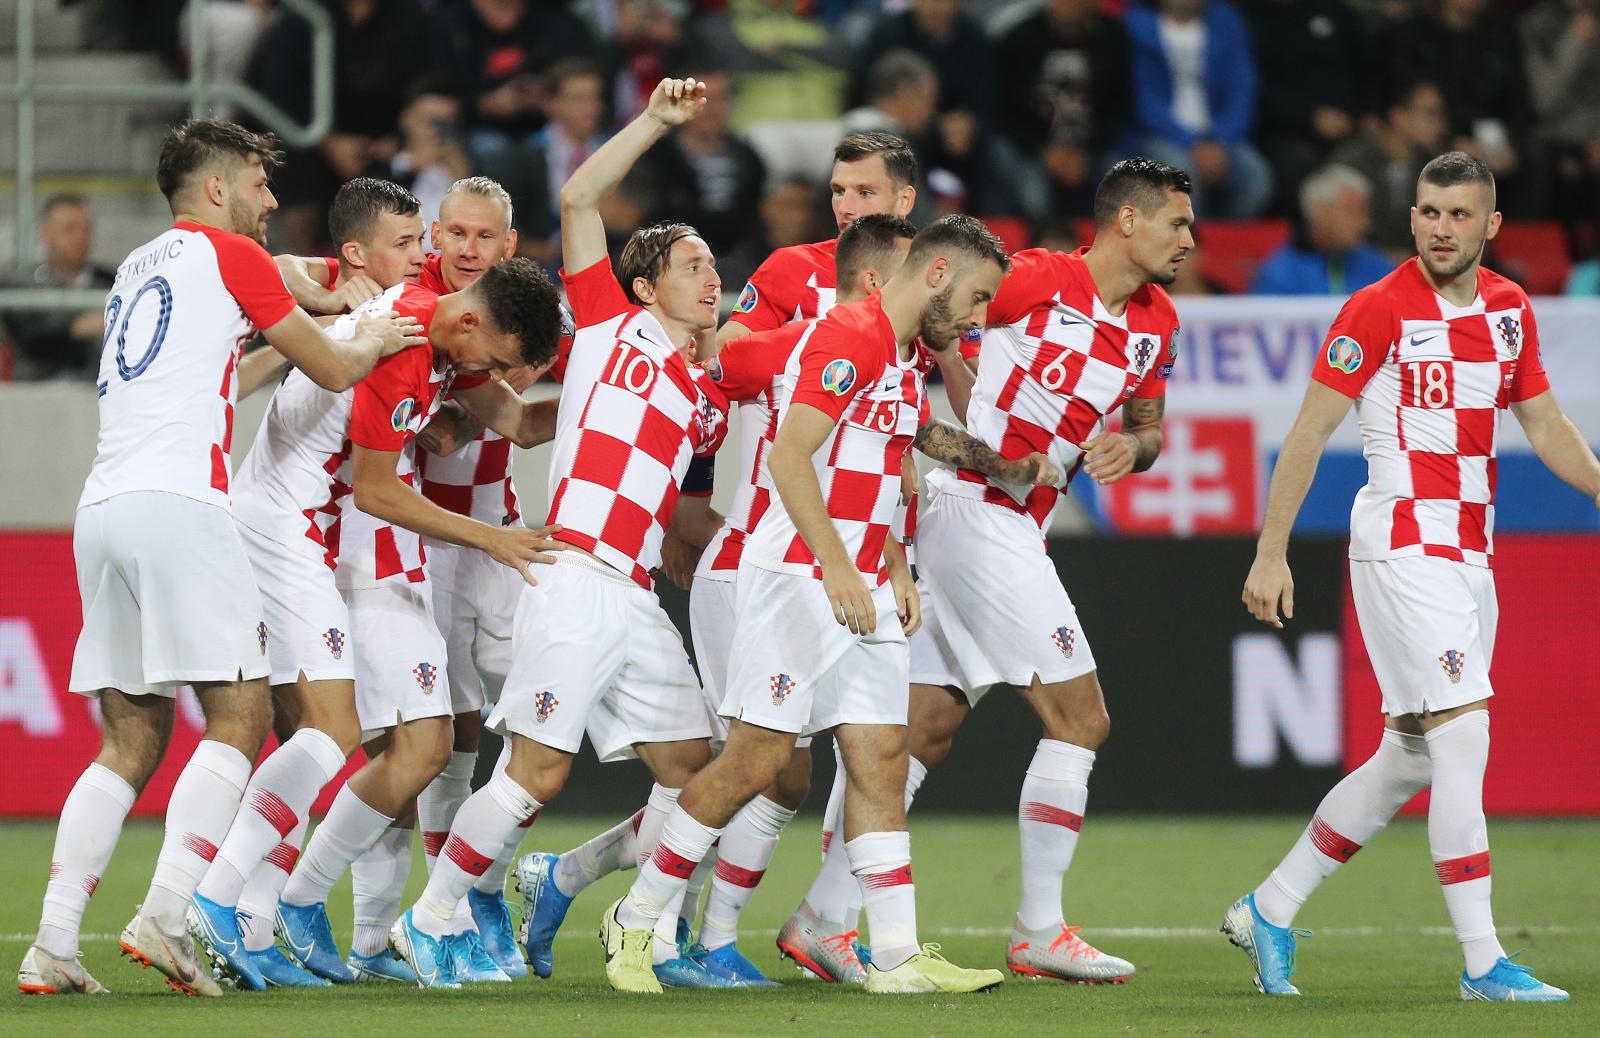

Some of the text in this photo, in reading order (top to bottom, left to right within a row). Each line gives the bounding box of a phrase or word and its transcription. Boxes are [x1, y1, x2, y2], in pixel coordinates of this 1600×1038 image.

[608, 342, 656, 395] 10
[1040, 348, 1073, 391] 6
[1407, 362, 1449, 409] 18
[1231, 633, 1342, 768] N
